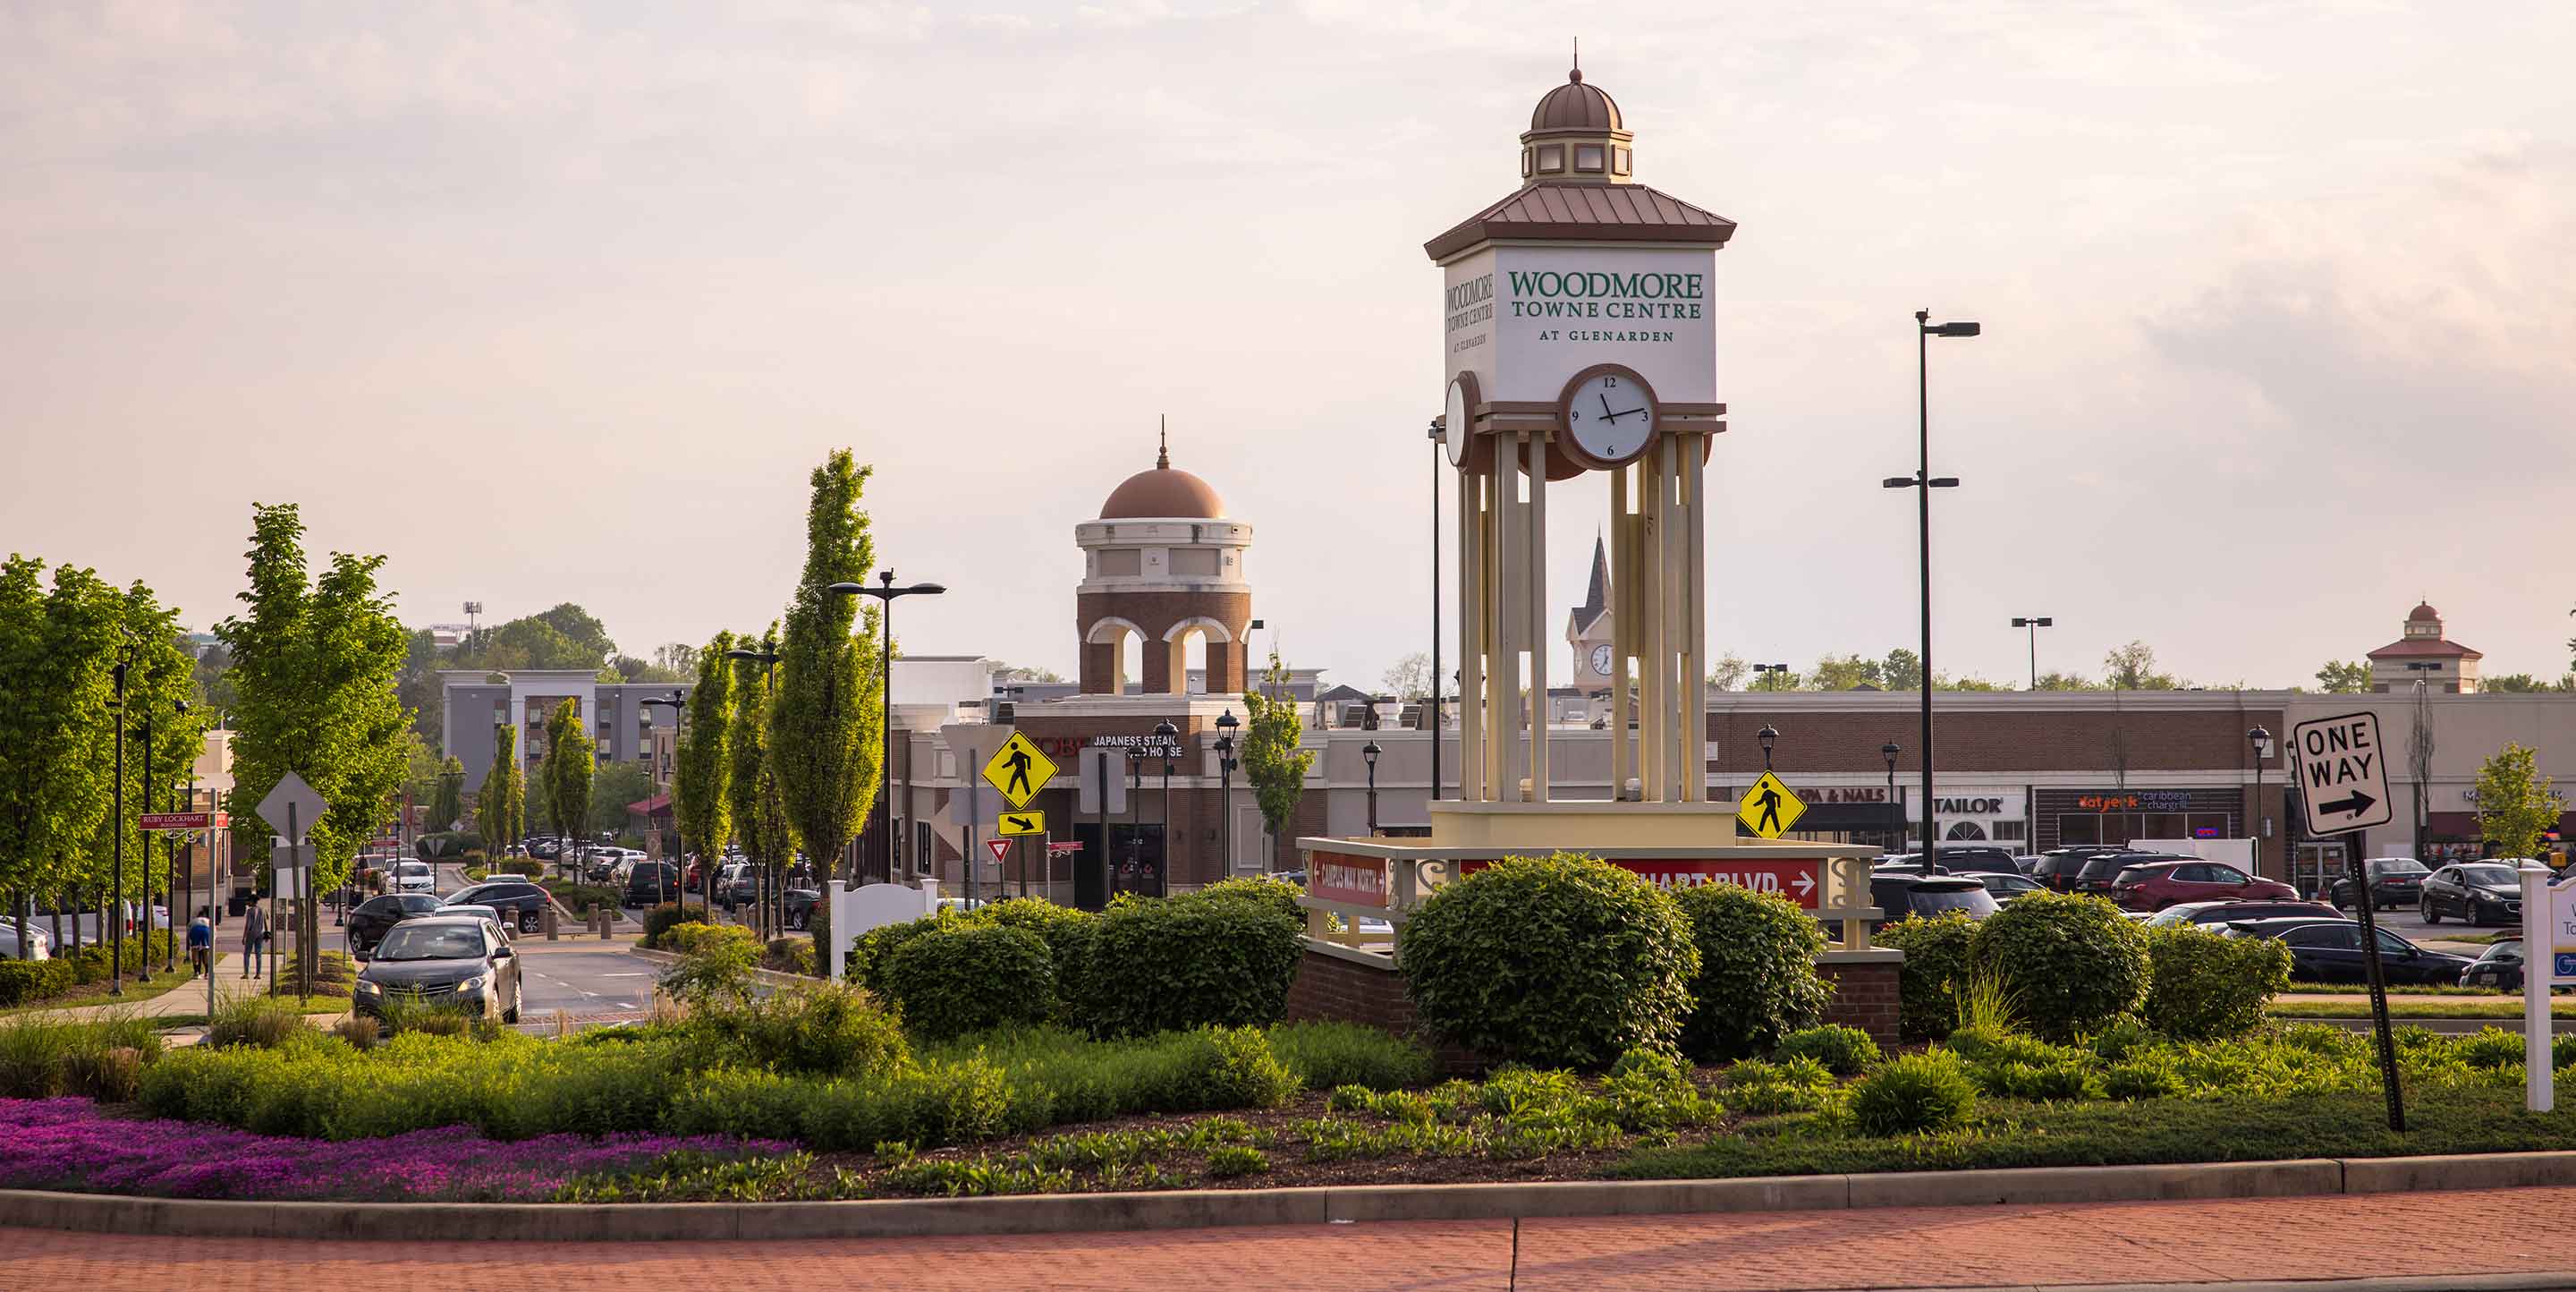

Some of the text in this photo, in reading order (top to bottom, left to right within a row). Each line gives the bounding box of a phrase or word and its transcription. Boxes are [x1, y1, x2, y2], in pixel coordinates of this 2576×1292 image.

[1508, 271, 1703, 300] WOODMORE
[1446, 273, 1494, 312] WOODMORE
[1512, 301, 1702, 319] TOWNE CENTRE
[1447, 302, 1493, 334] TOWNE CENTRE
[1461, 334, 1487, 351] GLENARDEN
[1539, 330, 1675, 343] AT GLENARDEN
[1603, 378, 1616, 388] 12
[1572, 411, 1580, 422] 9
[1641, 411, 1649, 422] 3
[1606, 446, 1614, 456] 6
[1094, 735, 1141, 746] JAPANESE
[2305, 721, 2370, 756] ONE
[1149, 747, 1182, 757] HOSE
[2308, 752, 2374, 788] WAY
[1797, 788, 1885, 802] SPA & NAILS
[2142, 790, 2191, 801] caribbean
[143, 815, 163, 823] RUBY
[1321, 862, 1377, 895] CAMPUS WAY NORTH
